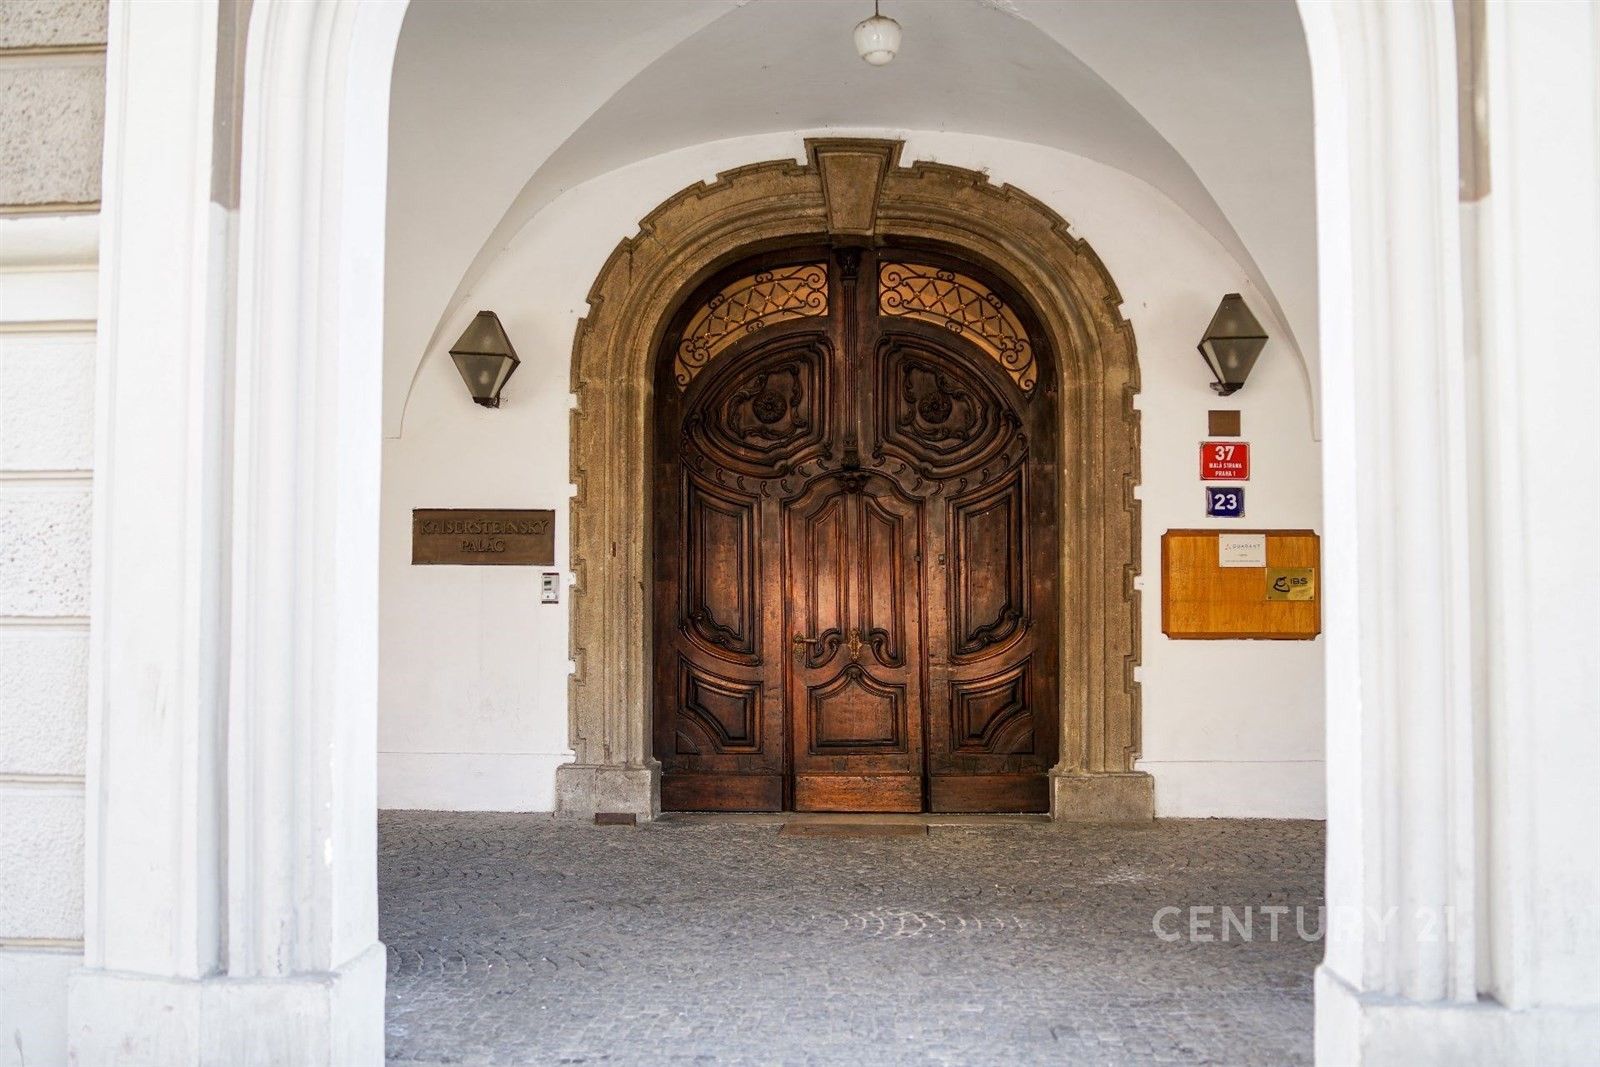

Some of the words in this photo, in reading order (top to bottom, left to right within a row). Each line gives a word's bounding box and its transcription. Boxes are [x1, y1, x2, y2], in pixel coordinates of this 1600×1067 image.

[1215, 445, 1235, 461] 37
[1209, 461, 1223, 469] MALÁ
[1214, 493, 1238, 510] 23
[460, 537, 506, 553] PALÁC
[1290, 577, 1308, 585] IBS
